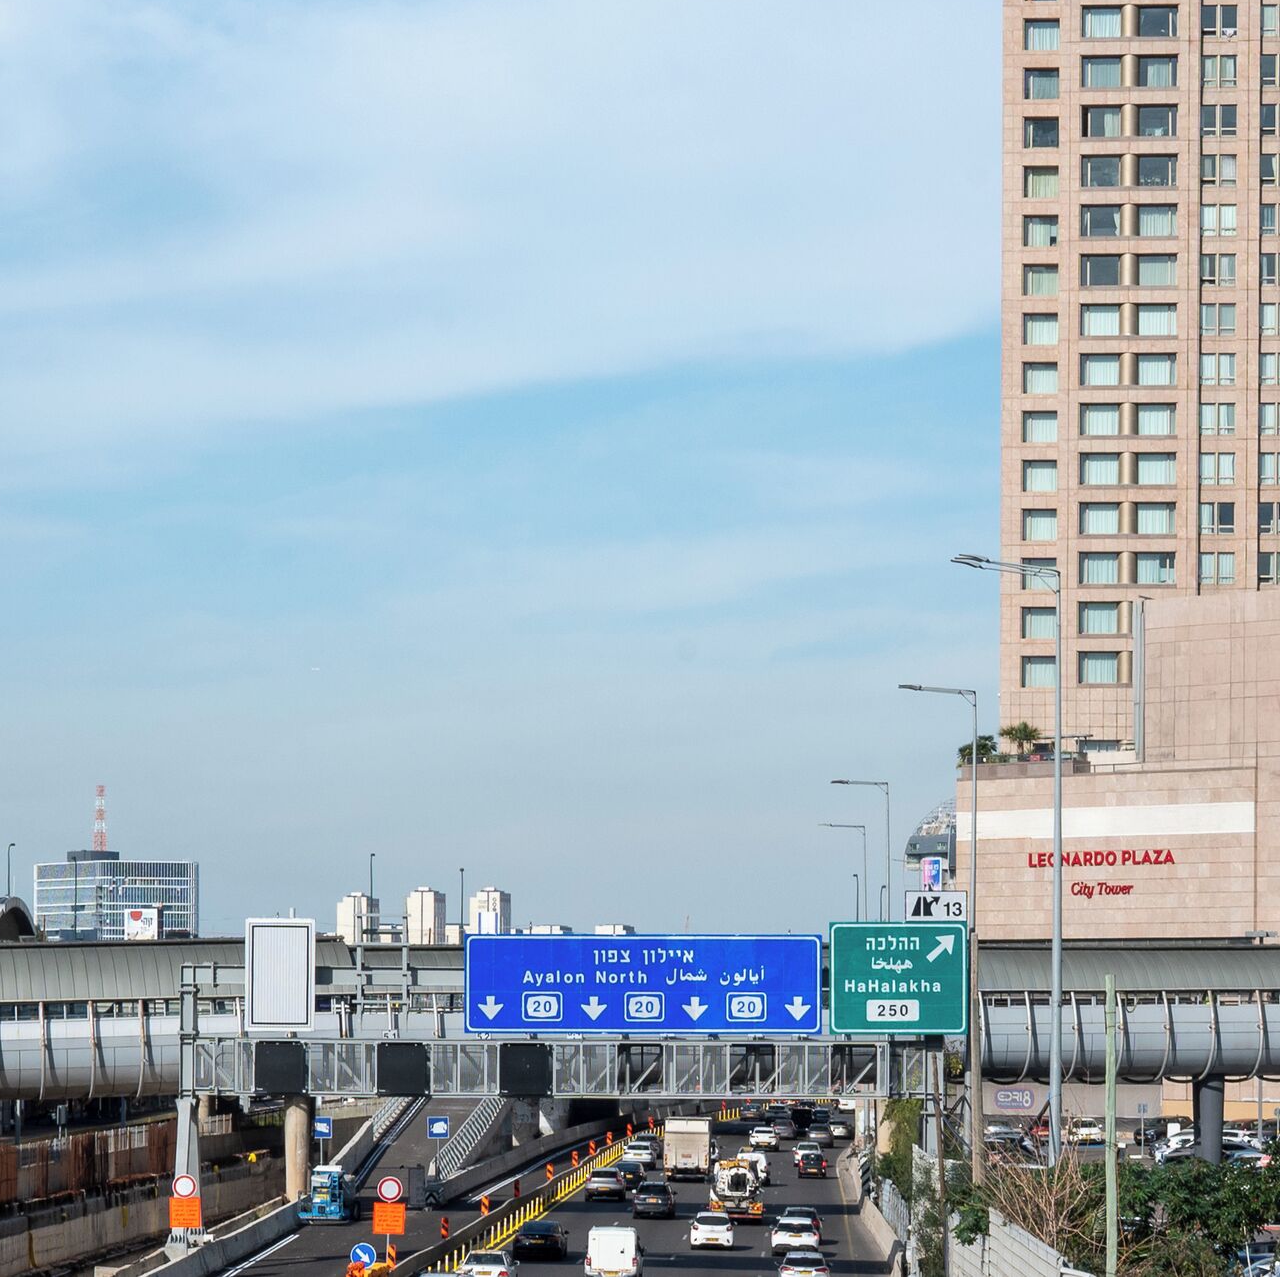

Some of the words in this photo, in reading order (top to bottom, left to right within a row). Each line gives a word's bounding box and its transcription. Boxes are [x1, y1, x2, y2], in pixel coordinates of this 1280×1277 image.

[1121, 849, 1175, 866] PLAZA
[1071, 882, 1095, 899] City
[1097, 882, 1134, 896] Tower
[943, 902, 963, 917] 13
[866, 935, 920, 951] ההלכה
[593, 949, 631, 965] צפון
[643, 947, 695, 965] איילון
[523, 970, 585, 987] Ayalon
[595, 970, 648, 984] North
[665, 968, 708, 986] شمال
[719, 966, 765, 986] أيالون
[844, 979, 942, 993] HaHalakha
[533, 1000, 552, 1013] 20
[634, 1000, 654, 1013] 20
[737, 1000, 756, 1013] 20
[877, 1004, 909, 1017] 250
